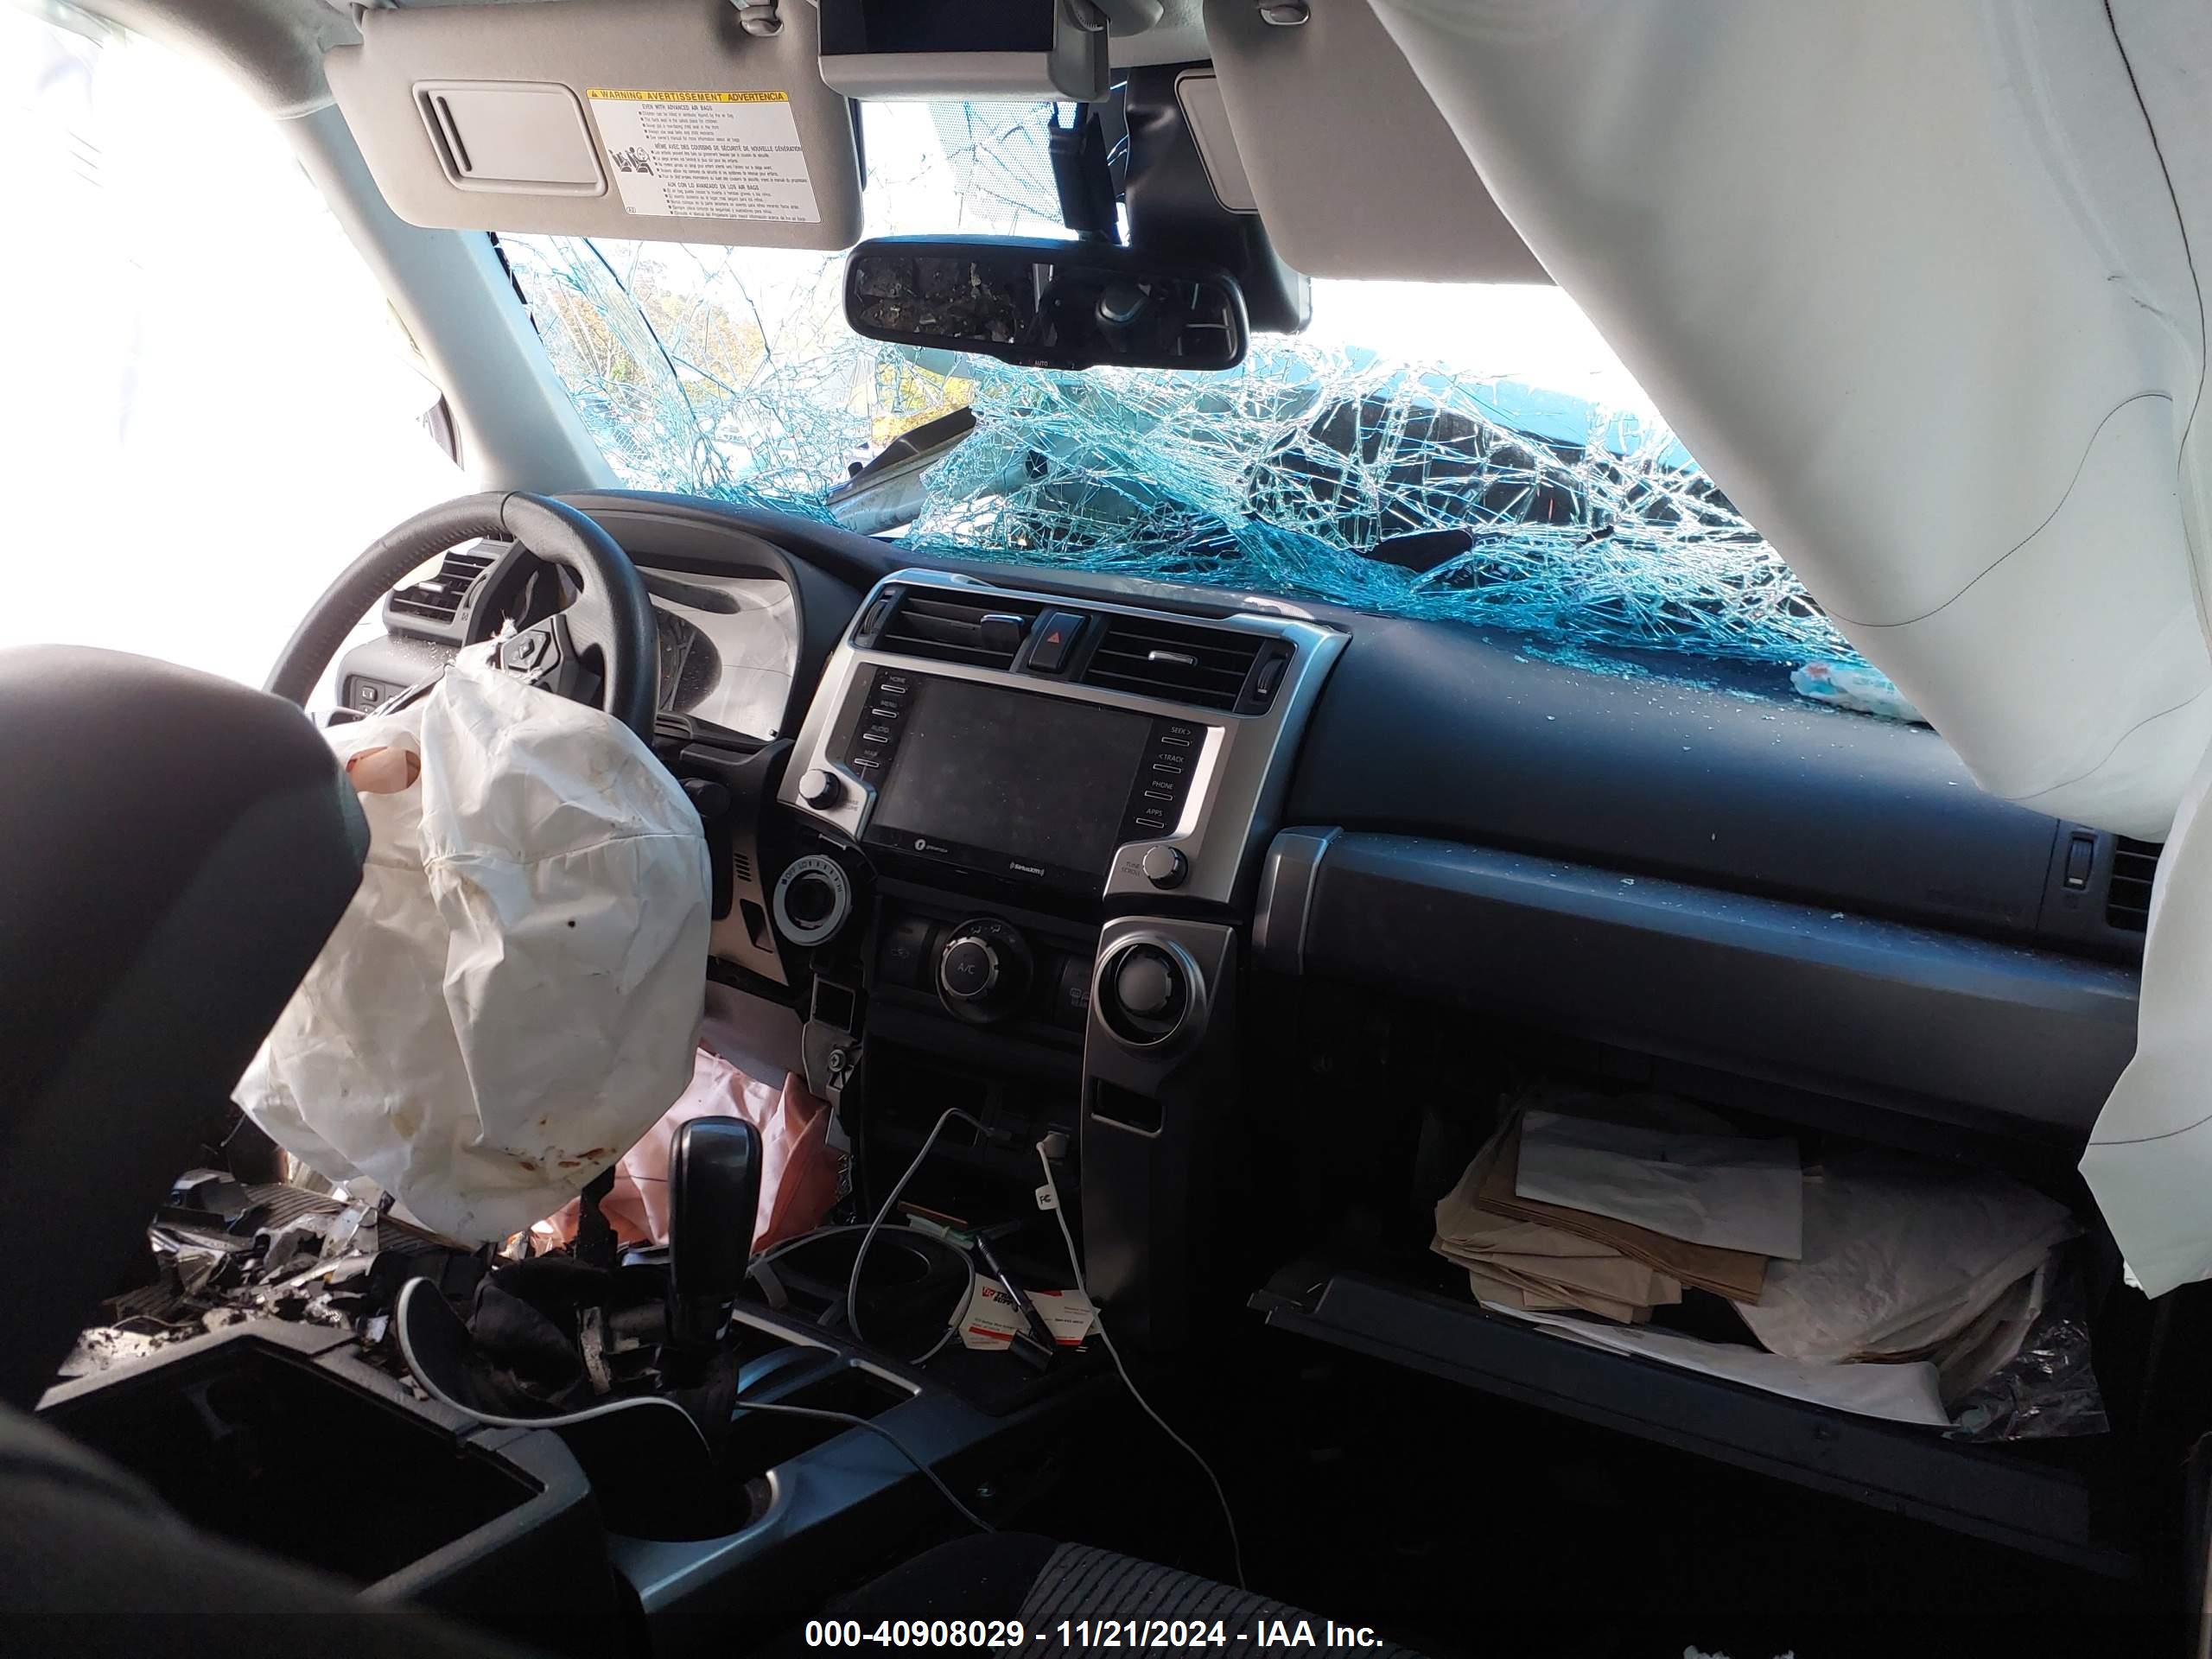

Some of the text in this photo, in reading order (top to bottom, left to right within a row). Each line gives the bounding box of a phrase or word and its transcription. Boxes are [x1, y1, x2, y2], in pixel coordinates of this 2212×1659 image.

[600, 91, 784, 102] WARNING AVERTISSEMENT ADVERTENCIA
[1152, 780, 1173, 789] PHONE
[1146, 808, 1163, 817] APPS
[957, 962, 976, 976] A/C
